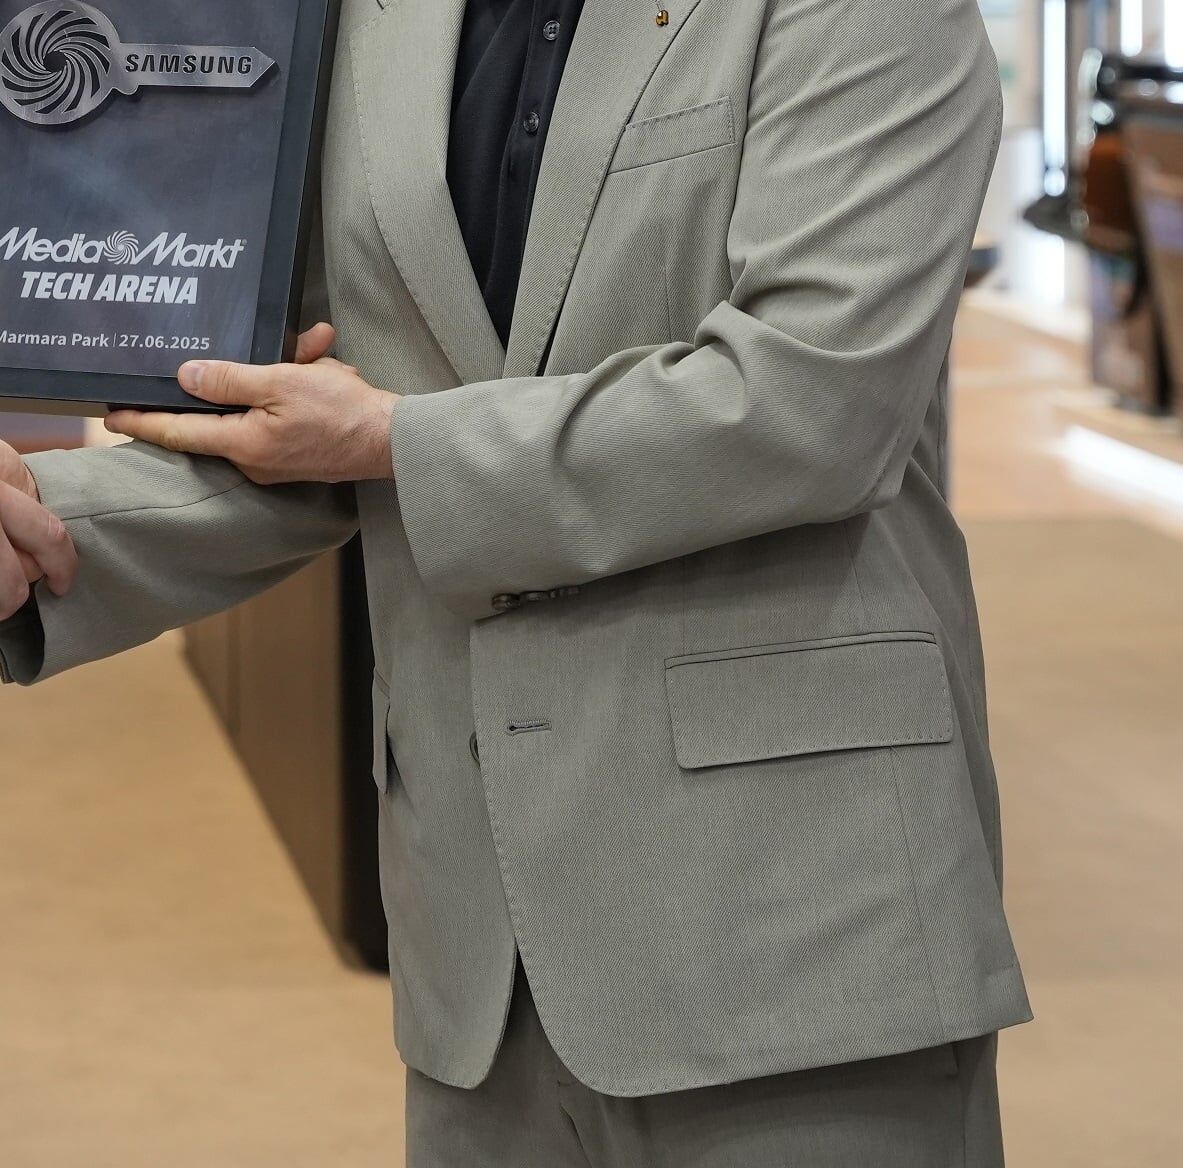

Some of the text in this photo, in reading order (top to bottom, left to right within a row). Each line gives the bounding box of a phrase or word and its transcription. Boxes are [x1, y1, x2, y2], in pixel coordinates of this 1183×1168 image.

[125, 53, 252, 75] SAMSUNG
[20, 270, 199, 305] TECH ARENA
[71, 333, 109, 348] Park
[119, 334, 210, 351] 27.06.2025
